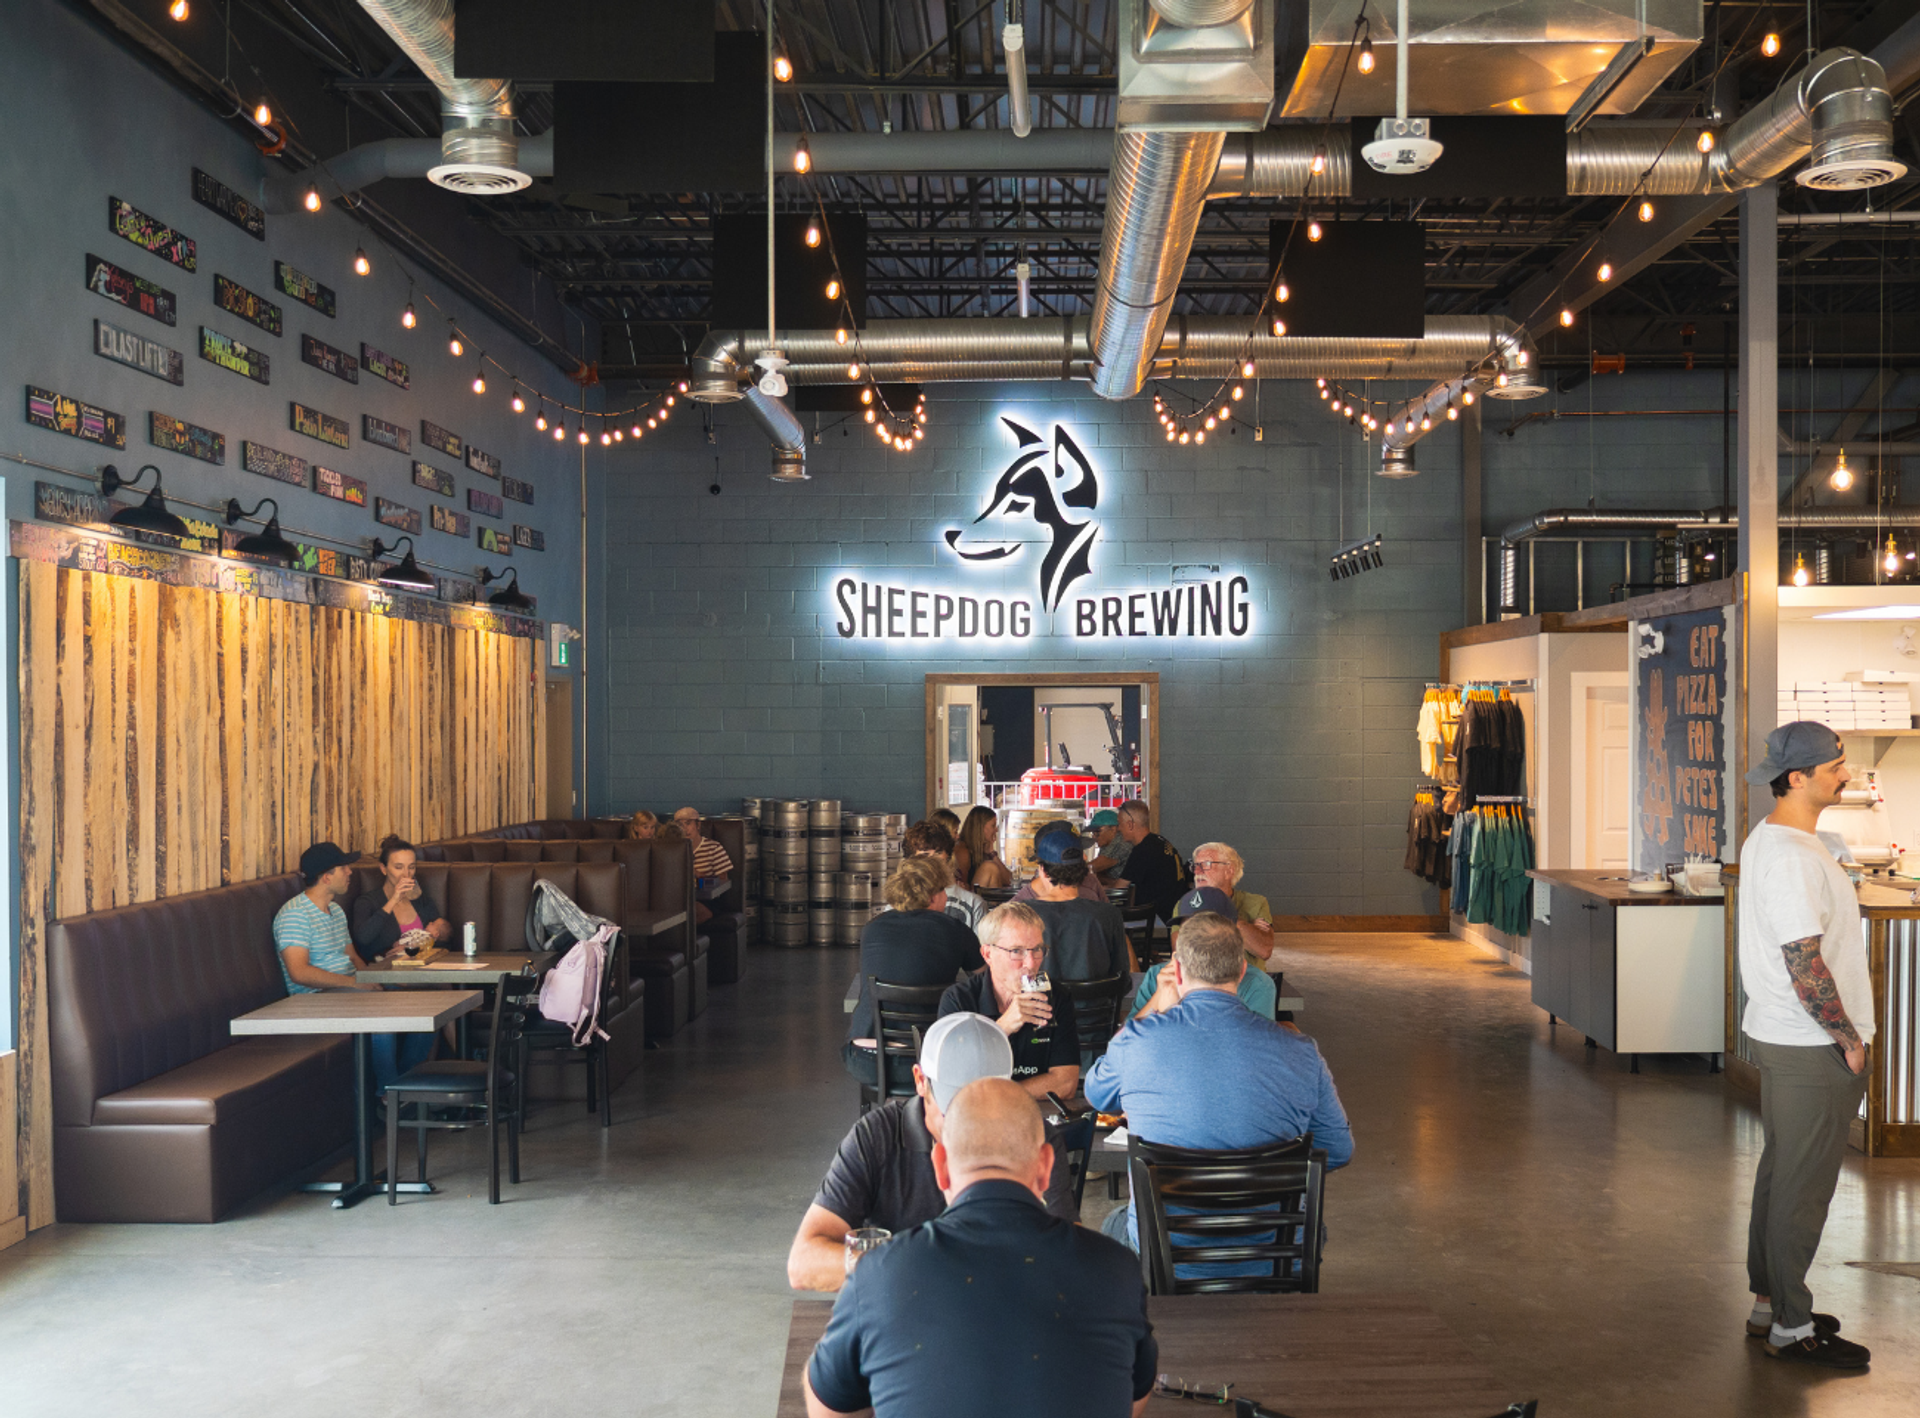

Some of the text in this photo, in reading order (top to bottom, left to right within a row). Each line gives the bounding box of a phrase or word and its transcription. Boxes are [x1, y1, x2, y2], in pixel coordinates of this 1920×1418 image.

[836, 575, 1249, 639] SHEEPDOG BREWING
[1689, 624, 1719, 668] EAT
[1676, 673, 1718, 716] PIZZA
[1687, 720, 1715, 762] FOR
[1675, 765, 1718, 811] PETE'S
[1683, 813, 1717, 858] SAKE
